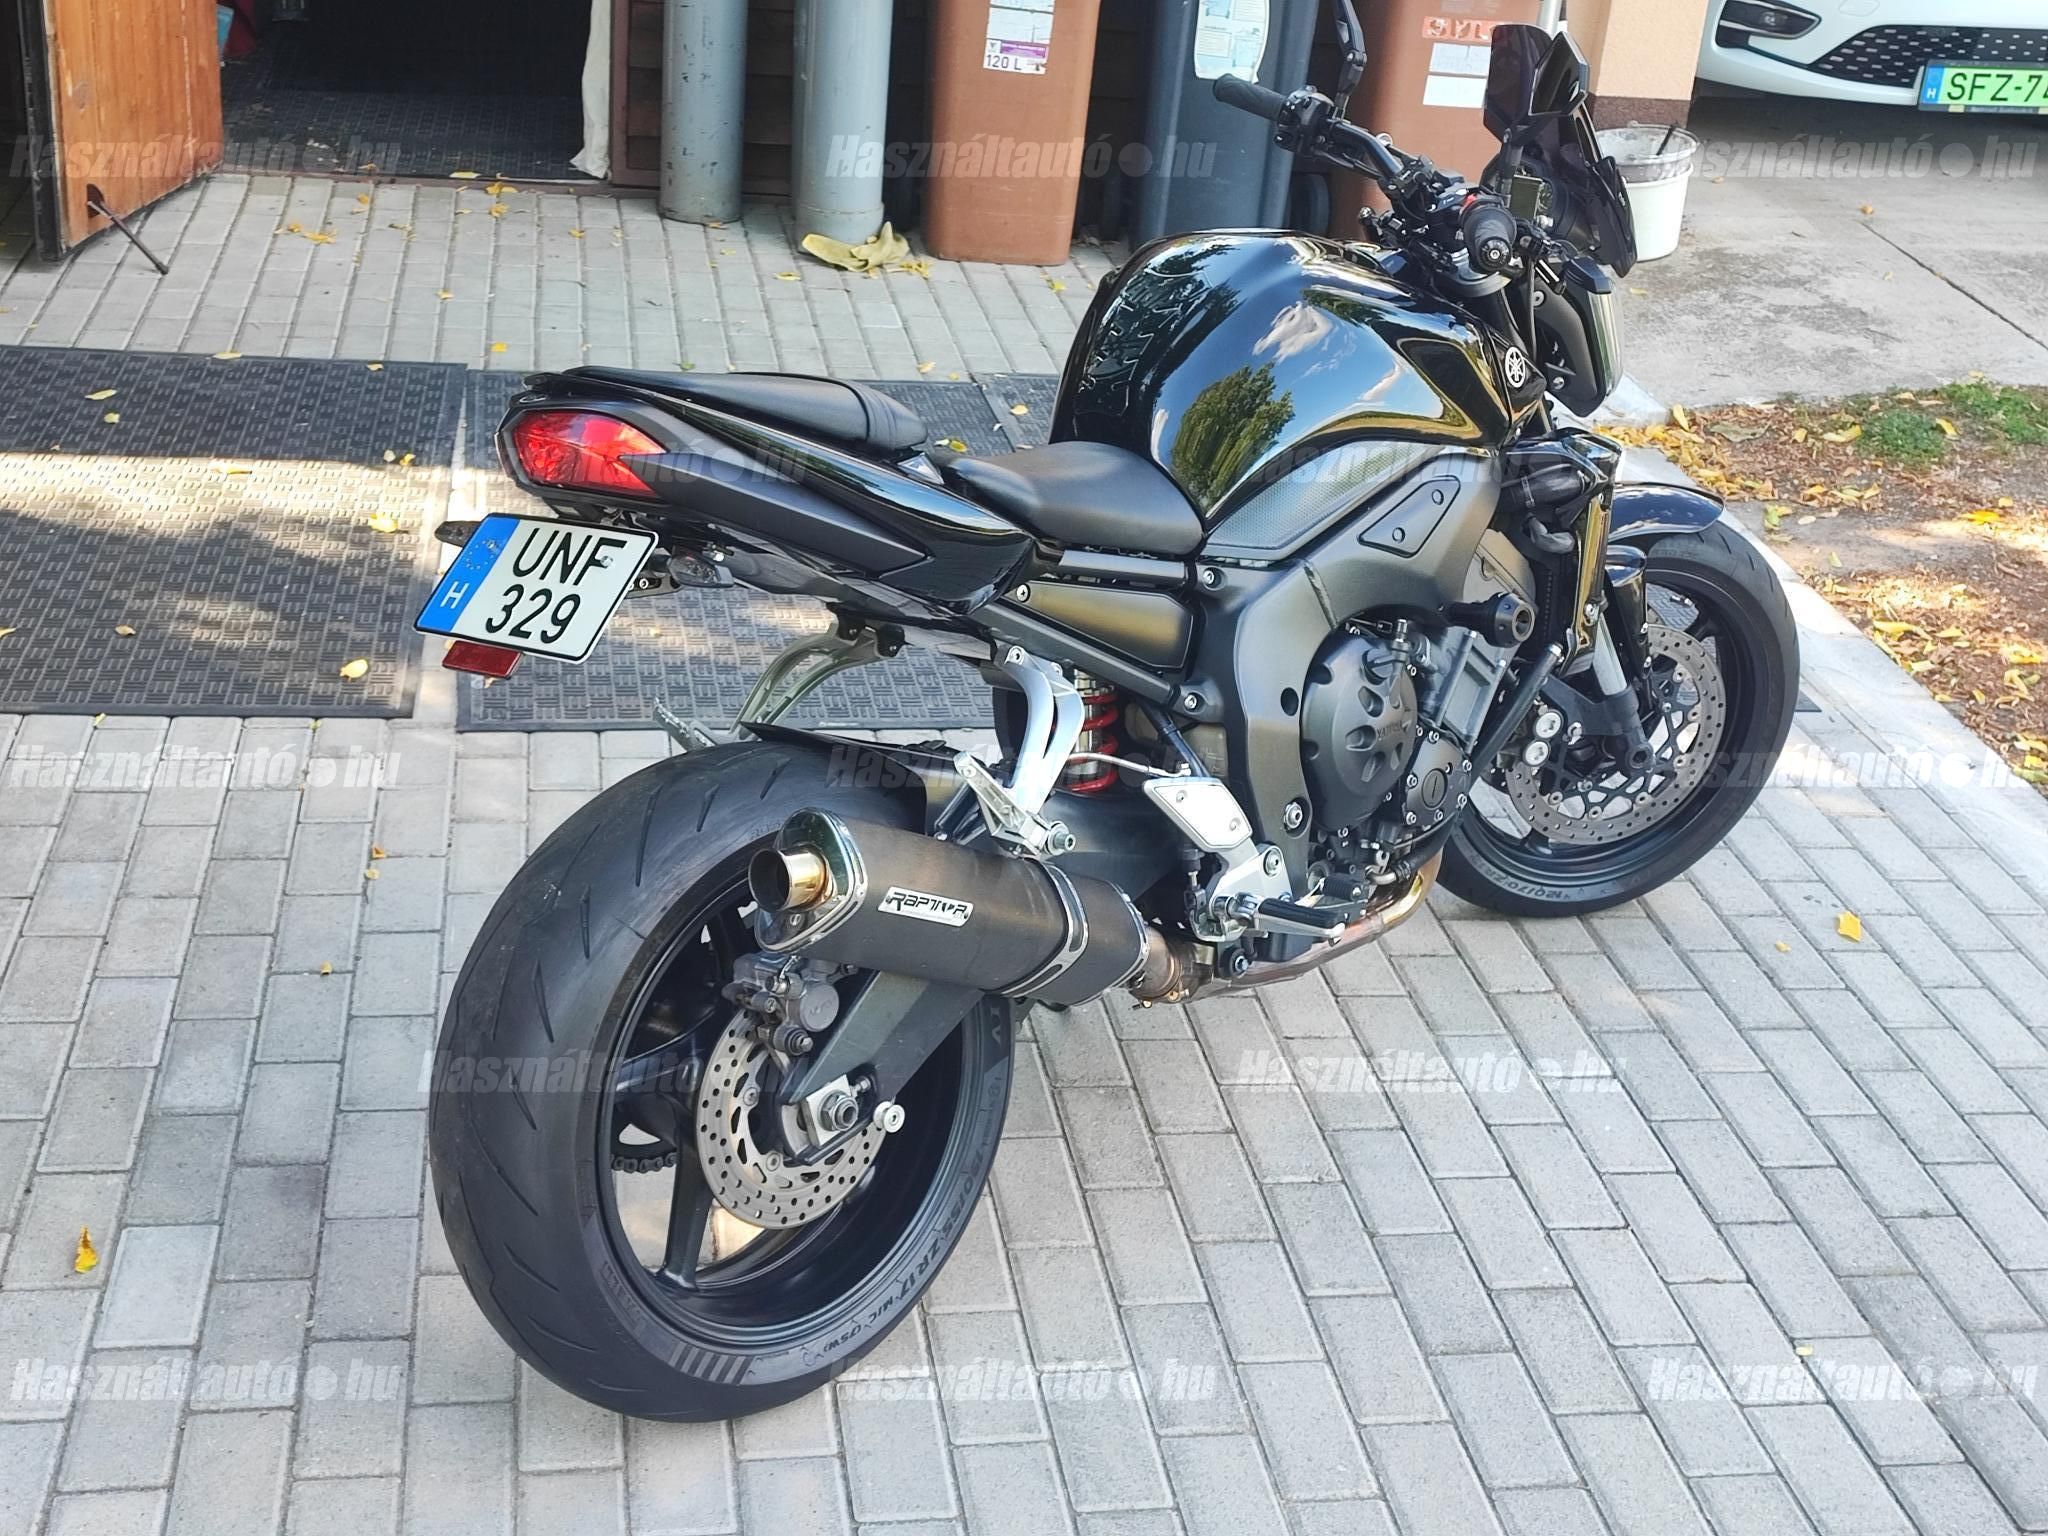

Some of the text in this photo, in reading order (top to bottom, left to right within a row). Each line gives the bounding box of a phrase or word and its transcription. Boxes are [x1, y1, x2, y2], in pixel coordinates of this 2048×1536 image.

[987, 54, 1009, 69] 120
[1014, 57, 1022, 71] L
[1926, 87, 1937, 99] H
[1946, 72, 2048, 103] SFZ-7
[512, 527, 628, 586] UNF
[440, 580, 469, 610] H
[485, 584, 581, 644] 329
